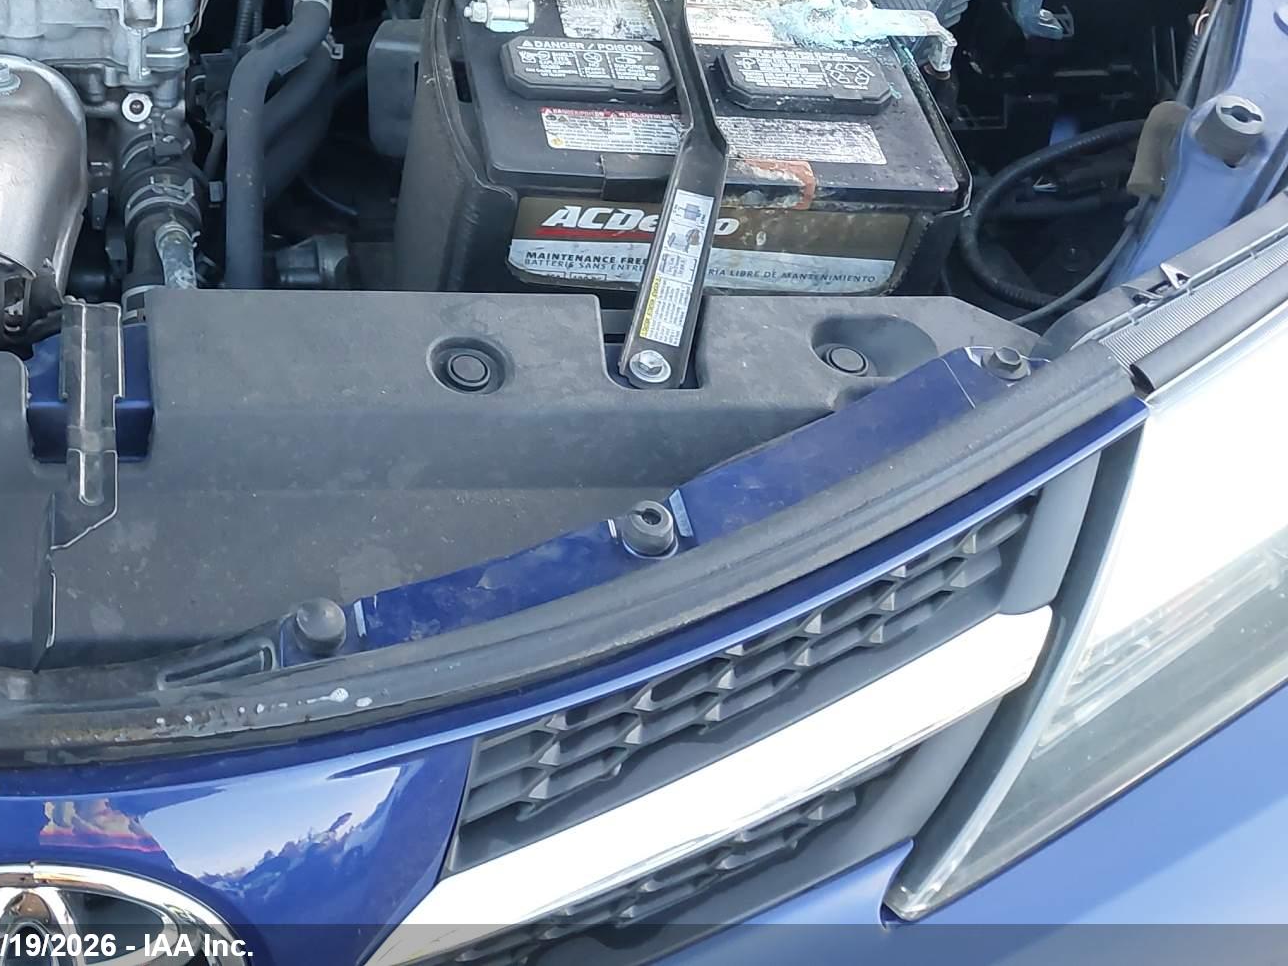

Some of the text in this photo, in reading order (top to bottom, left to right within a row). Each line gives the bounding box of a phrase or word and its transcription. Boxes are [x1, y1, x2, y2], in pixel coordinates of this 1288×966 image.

[534, 40, 585, 50] DANGER
[598, 43, 644, 52] POISON
[541, 205, 741, 236] ACDeo
[525, 250, 616, 264] MAINTENANCE
[578, 261, 607, 270] SANS
[729, 268, 761, 278] LIBRE
[781, 271, 877, 283] MANTENIMIENTO
